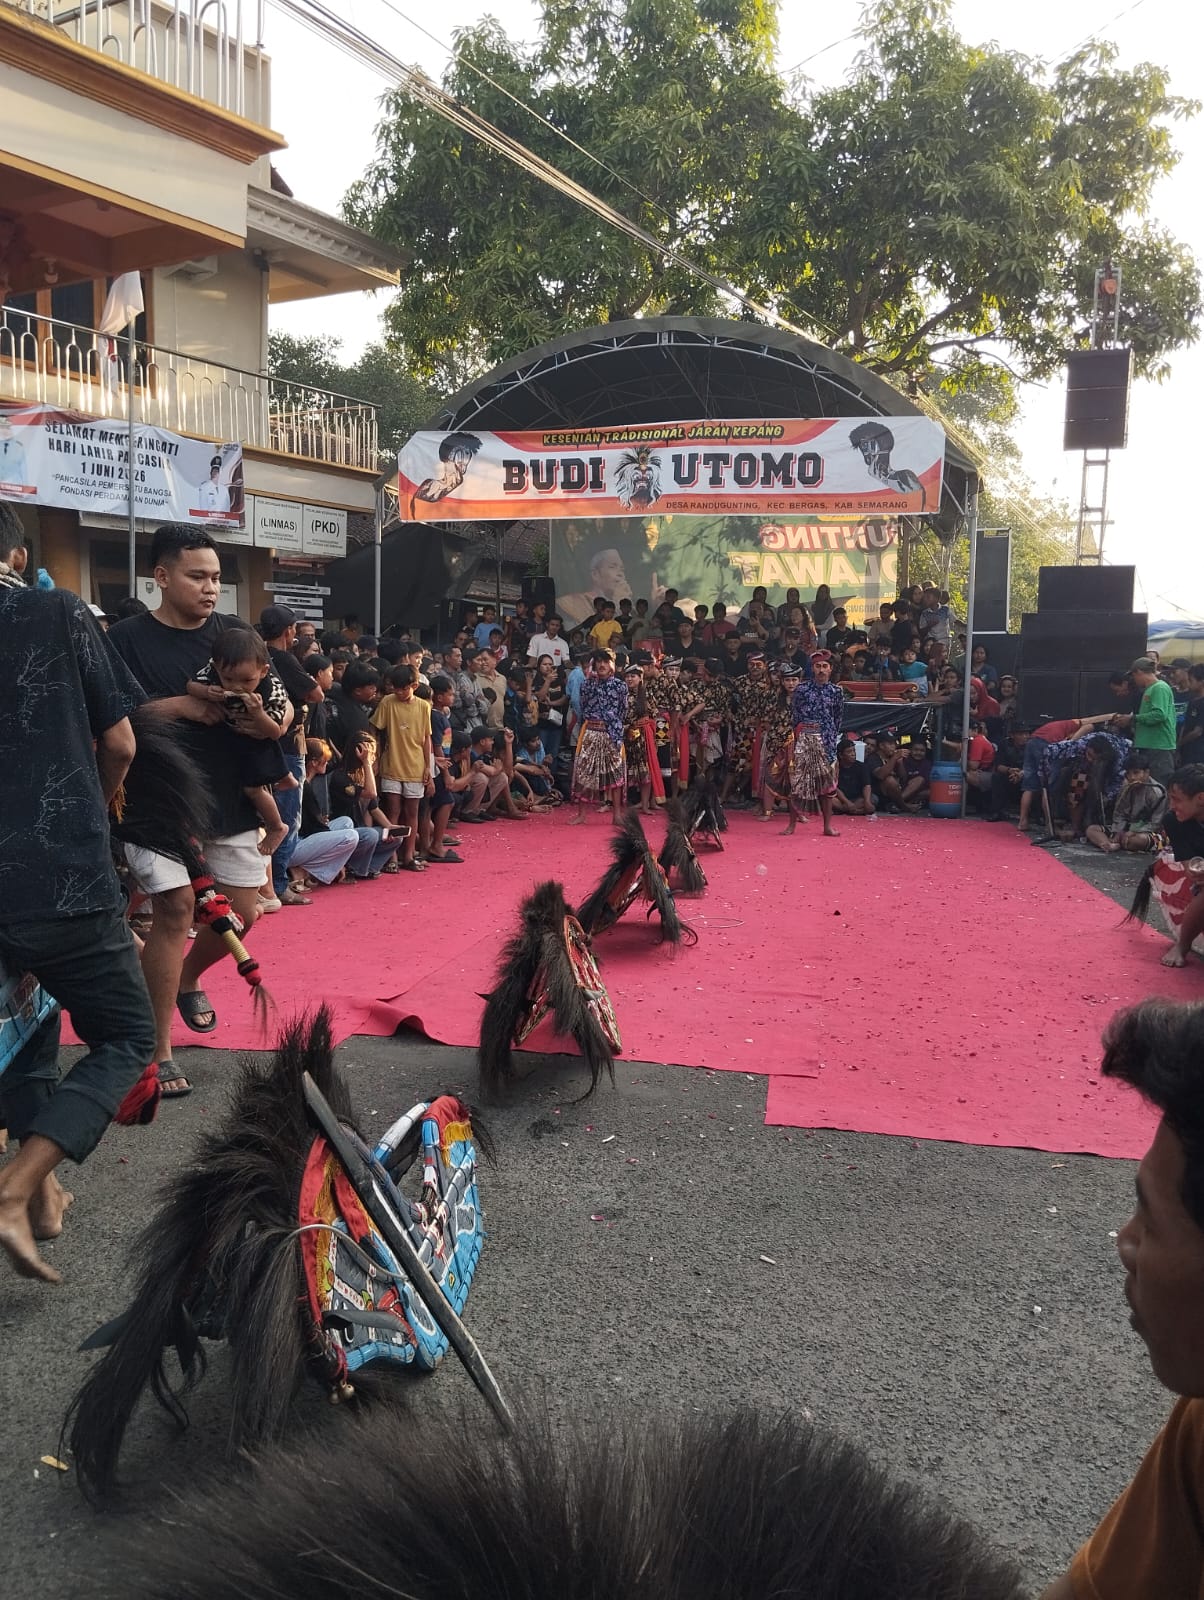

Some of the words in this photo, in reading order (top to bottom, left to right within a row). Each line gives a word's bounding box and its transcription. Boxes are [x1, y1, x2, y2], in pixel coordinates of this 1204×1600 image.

[45, 421, 96, 440] SELAMAT
[543, 432, 600, 445] KESENIAN
[605, 427, 684, 442] TRADISIONAL
[688, 426, 729, 438] JARAN
[732, 424, 785, 438] KEPANG
[48, 437, 76, 455] HARI
[81, 443, 114, 461] LAHIR
[81, 462, 86, 474] 1
[91, 463, 114, 478] JUNI
[502, 457, 606, 494] BUDI
[671, 452, 824, 488] UTOMO
[60, 485, 92, 497] FONDASI
[98, 481, 143, 493] PEMERSTU
[858, 501, 908, 509] SEMARANG
[261, 517, 297, 533] (LINMAS)
[311, 519, 339, 537] (PKD)
